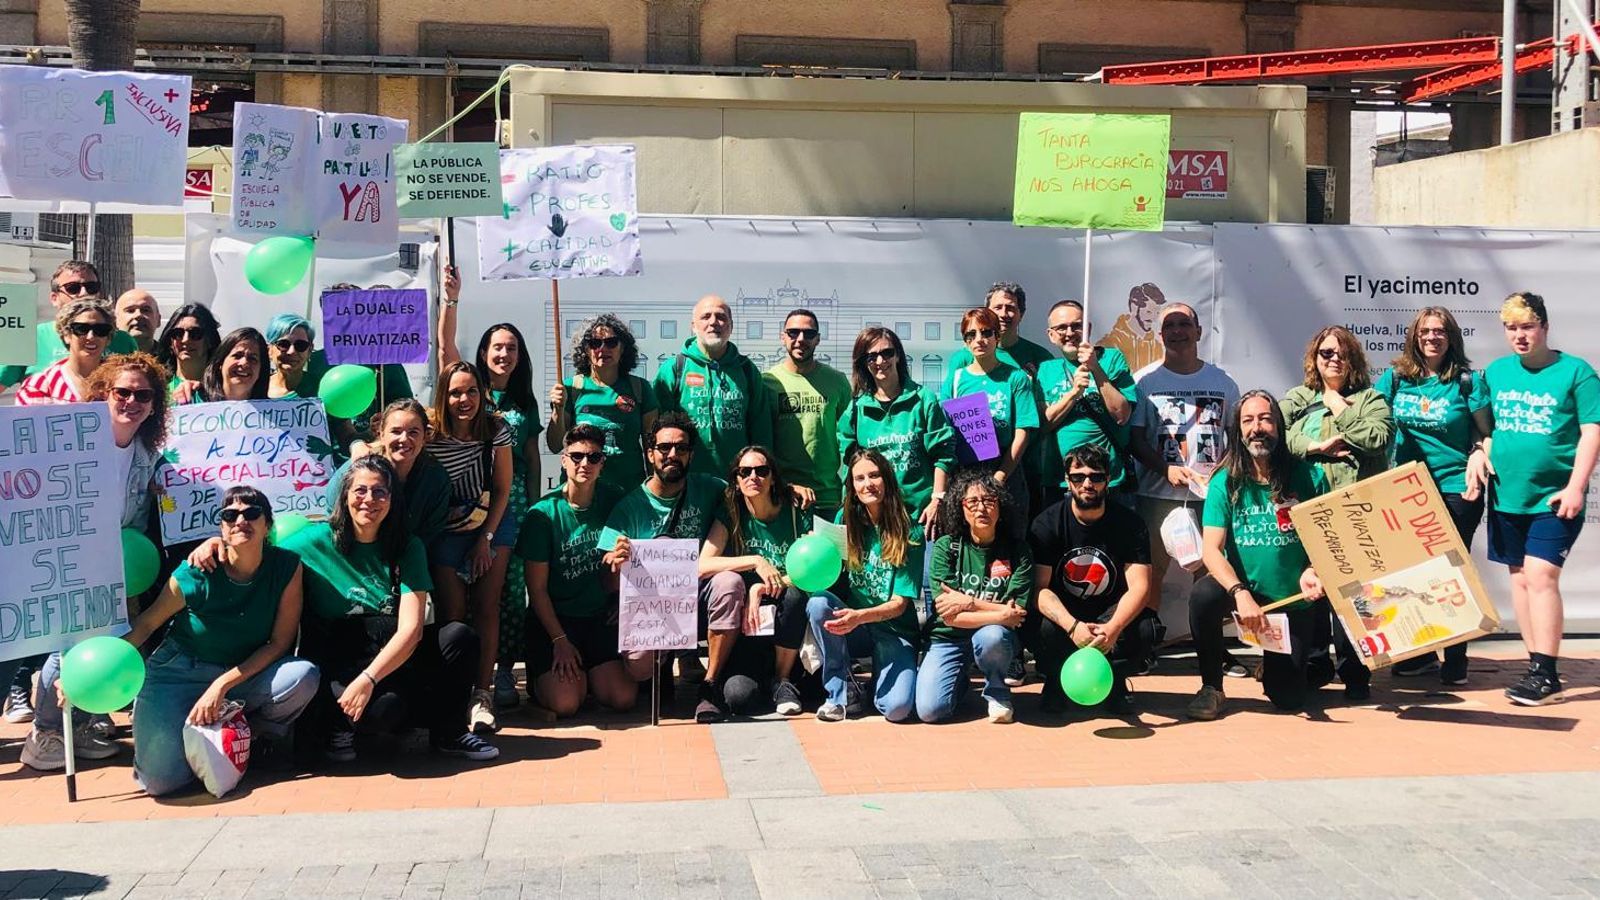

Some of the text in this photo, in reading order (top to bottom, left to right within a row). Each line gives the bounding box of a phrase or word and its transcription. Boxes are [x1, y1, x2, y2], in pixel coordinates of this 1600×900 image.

[95, 90, 115, 125] 1
[1038, 128, 1092, 149] TANTA
[413, 156, 483, 169] LA PÚBLICA
[242, 184, 280, 194] ESCUELA
[407, 173, 491, 184] NO SE VENDE,
[1029, 178, 1133, 193] NOS AHOGA
[339, 181, 381, 223] YA
[409, 189, 491, 200] SE DEFIENDE.
[530, 192, 611, 216] PROFES
[1344, 275, 1480, 299] El yacimento
[336, 303, 415, 316] LA DUAL ES
[332, 332, 421, 347] PRIVATIZAR
[801, 404, 821, 413] FACE
[975, 420, 987, 429] ES
[206, 436, 225, 460] A
[47, 461, 99, 501] SE
[164, 458, 326, 488] ESPECIALISTAS
[190, 488, 217, 508] DE
[0, 502, 97, 547] VENDE
[1342, 500, 1386, 572] PRIVATIZAR
[1408, 510, 1451, 556] DUAL
[31, 545, 86, 592] SE
[0, 582, 127, 643] DEFIENDE
